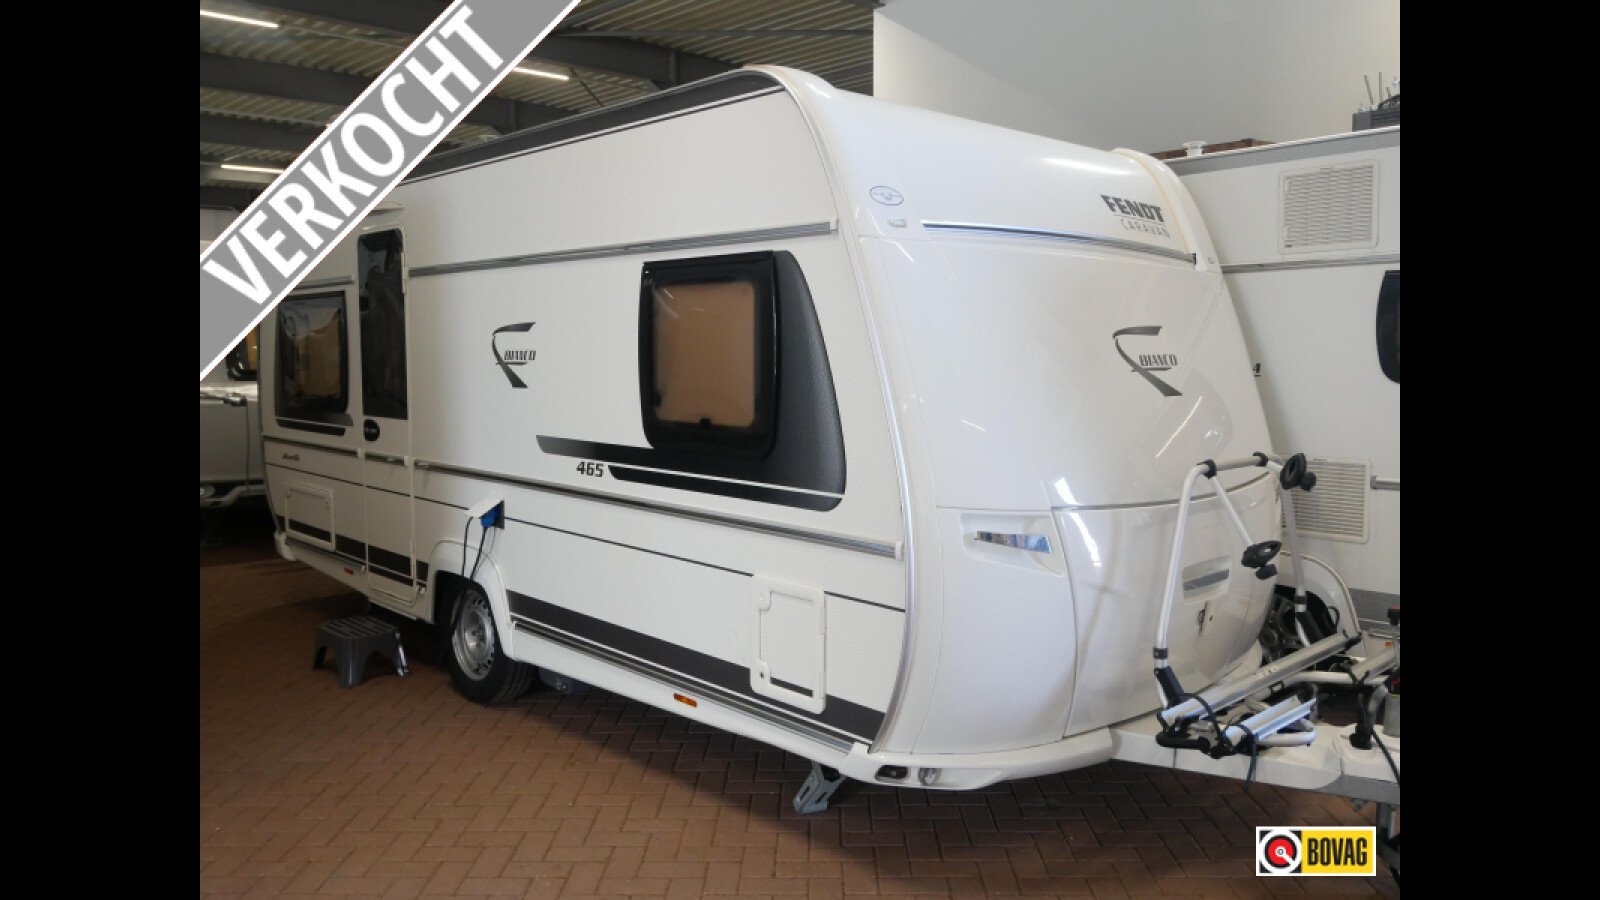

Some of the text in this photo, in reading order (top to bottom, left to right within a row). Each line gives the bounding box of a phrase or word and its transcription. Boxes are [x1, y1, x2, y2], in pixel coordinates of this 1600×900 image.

[1100, 194, 1164, 223] FENDT
[1120, 218, 1171, 239] CARAVAN
[503, 350, 537, 361] BIANCO
[1138, 353, 1179, 367] BIANCO
[576, 461, 604, 478] 465
